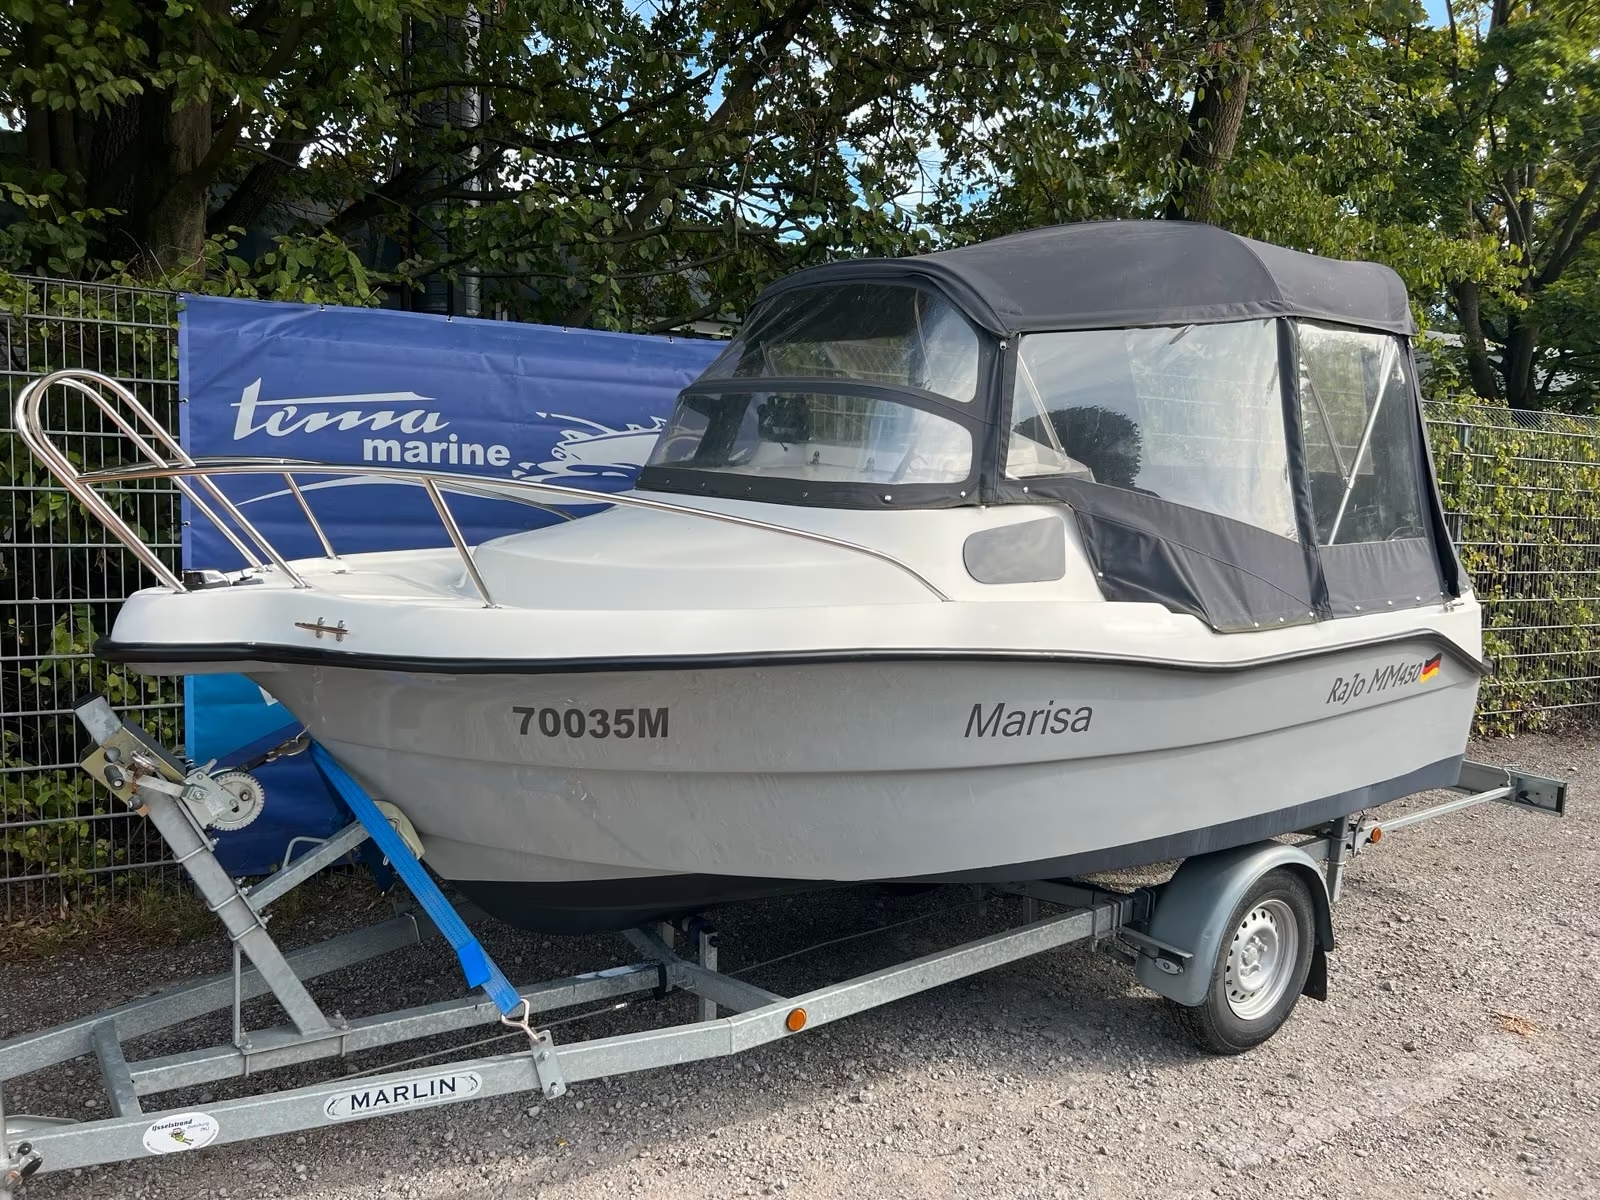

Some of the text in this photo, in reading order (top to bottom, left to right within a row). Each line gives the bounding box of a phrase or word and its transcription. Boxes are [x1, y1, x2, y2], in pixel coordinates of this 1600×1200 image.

[230, 377, 450, 440] tema
[362, 433, 511, 467] marine
[1325, 662, 1423, 705] RaJo MM450
[512, 706, 669, 739] 70035M
[964, 700, 1093, 738] Marisa
[350, 1077, 456, 1111] MARLIN
